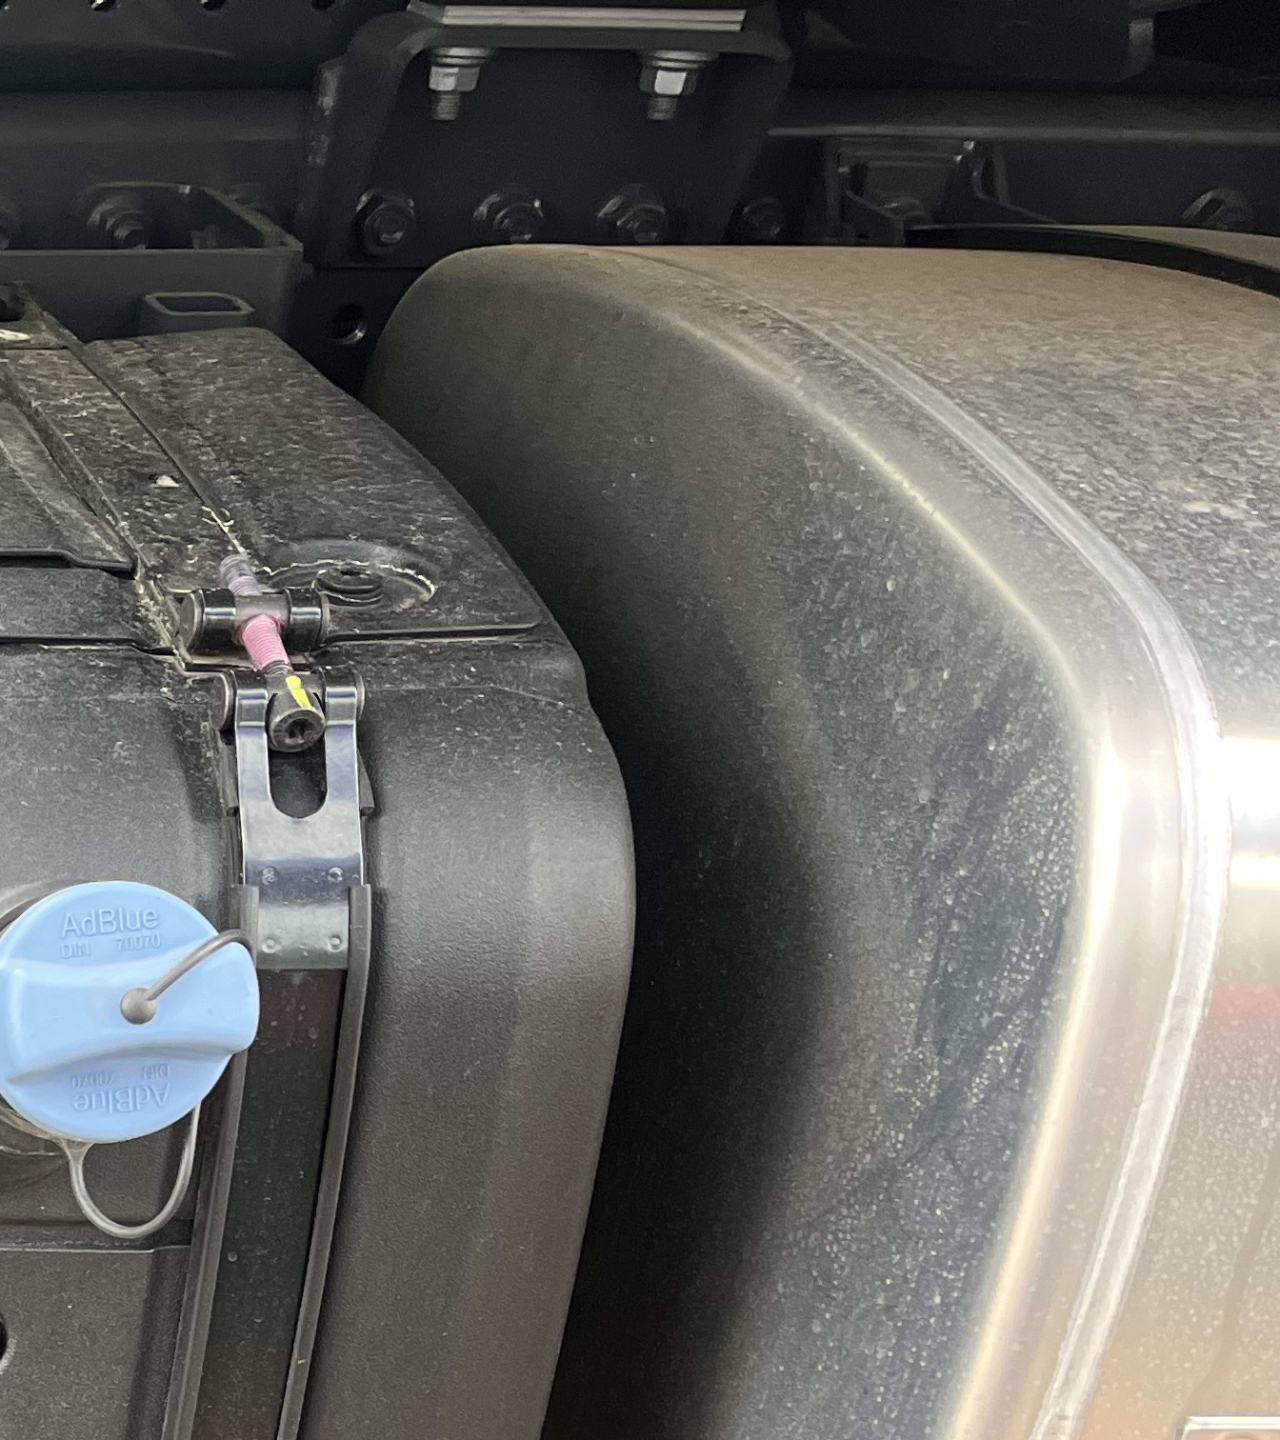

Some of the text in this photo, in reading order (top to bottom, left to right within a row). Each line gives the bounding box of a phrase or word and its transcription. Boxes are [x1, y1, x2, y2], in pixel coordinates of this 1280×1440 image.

[61, 907, 160, 938] AdBlue
[60, 942, 91, 959] DIN
[73, 1082, 170, 1113] AdBlue
